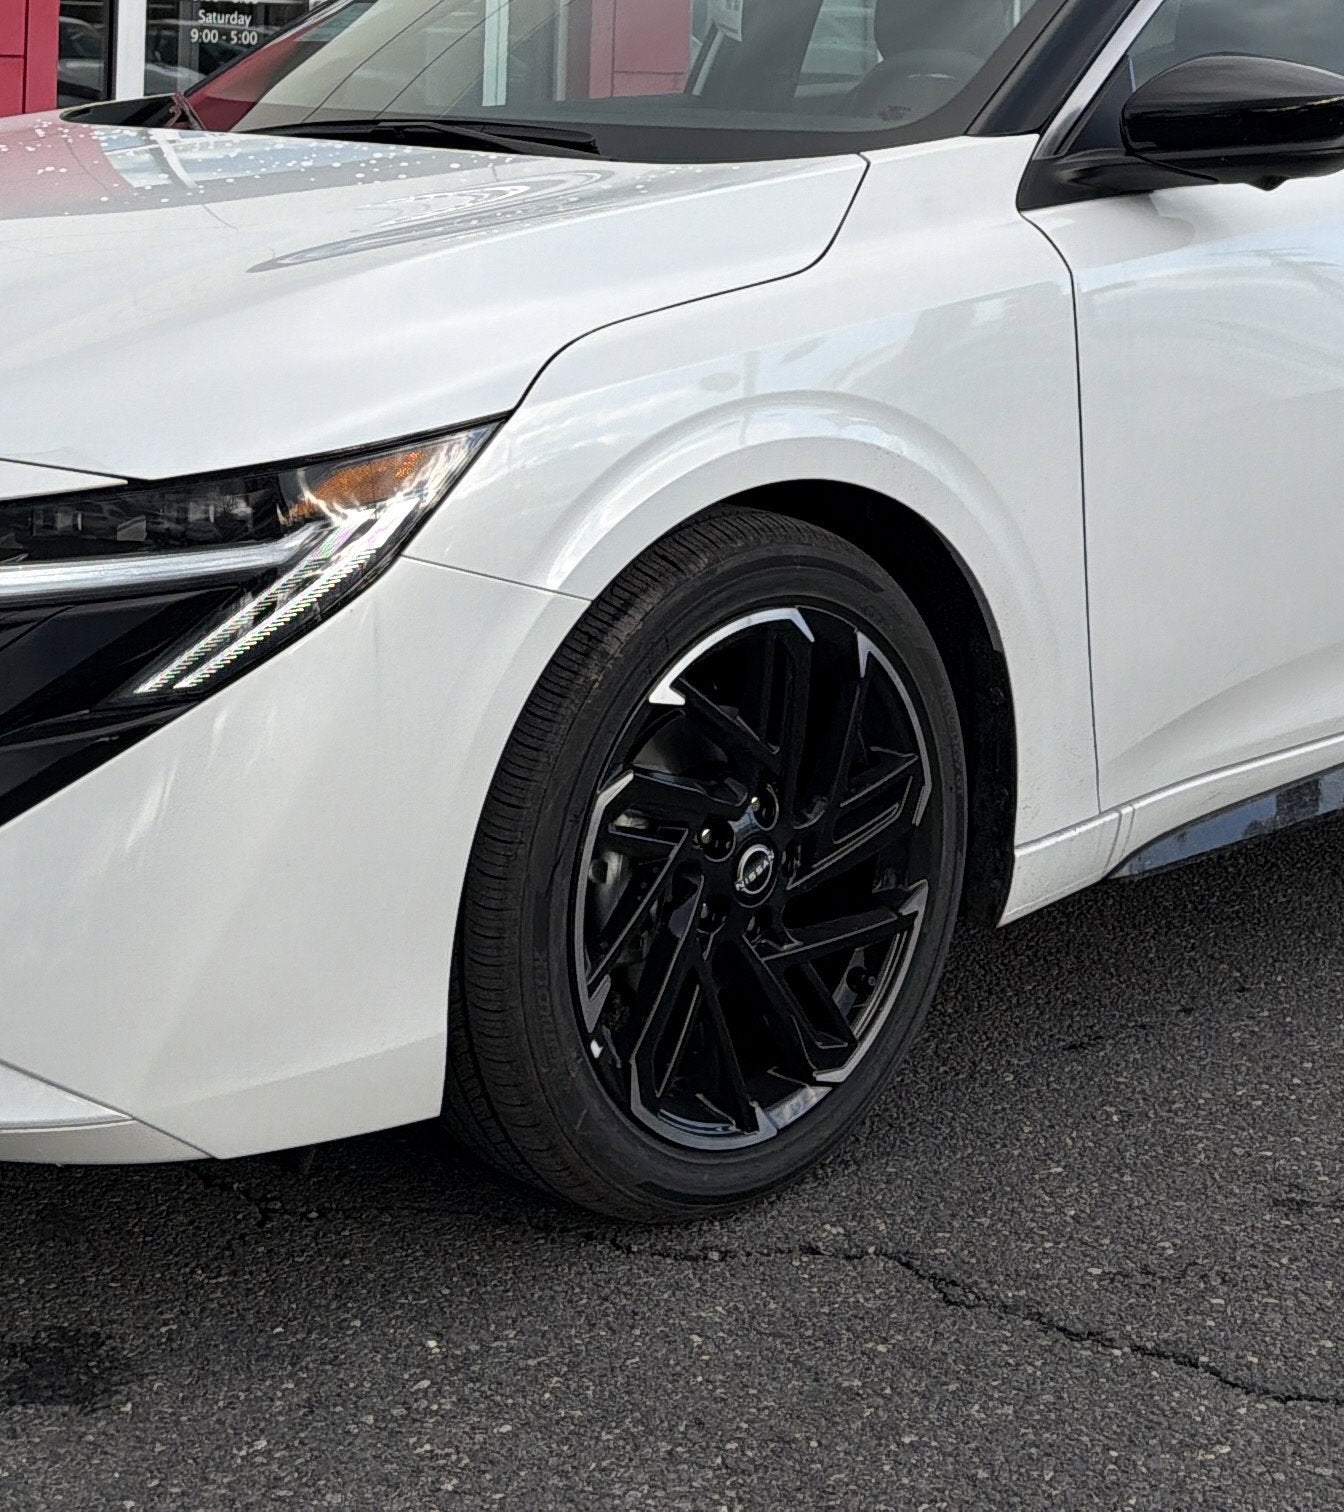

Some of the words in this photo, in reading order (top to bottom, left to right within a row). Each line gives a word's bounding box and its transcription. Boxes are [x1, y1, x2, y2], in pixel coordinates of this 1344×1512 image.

[198, 9, 253, 29] Saturday
[190, 28, 219, 44] 9:00
[230, 30, 258, 45] 5:00
